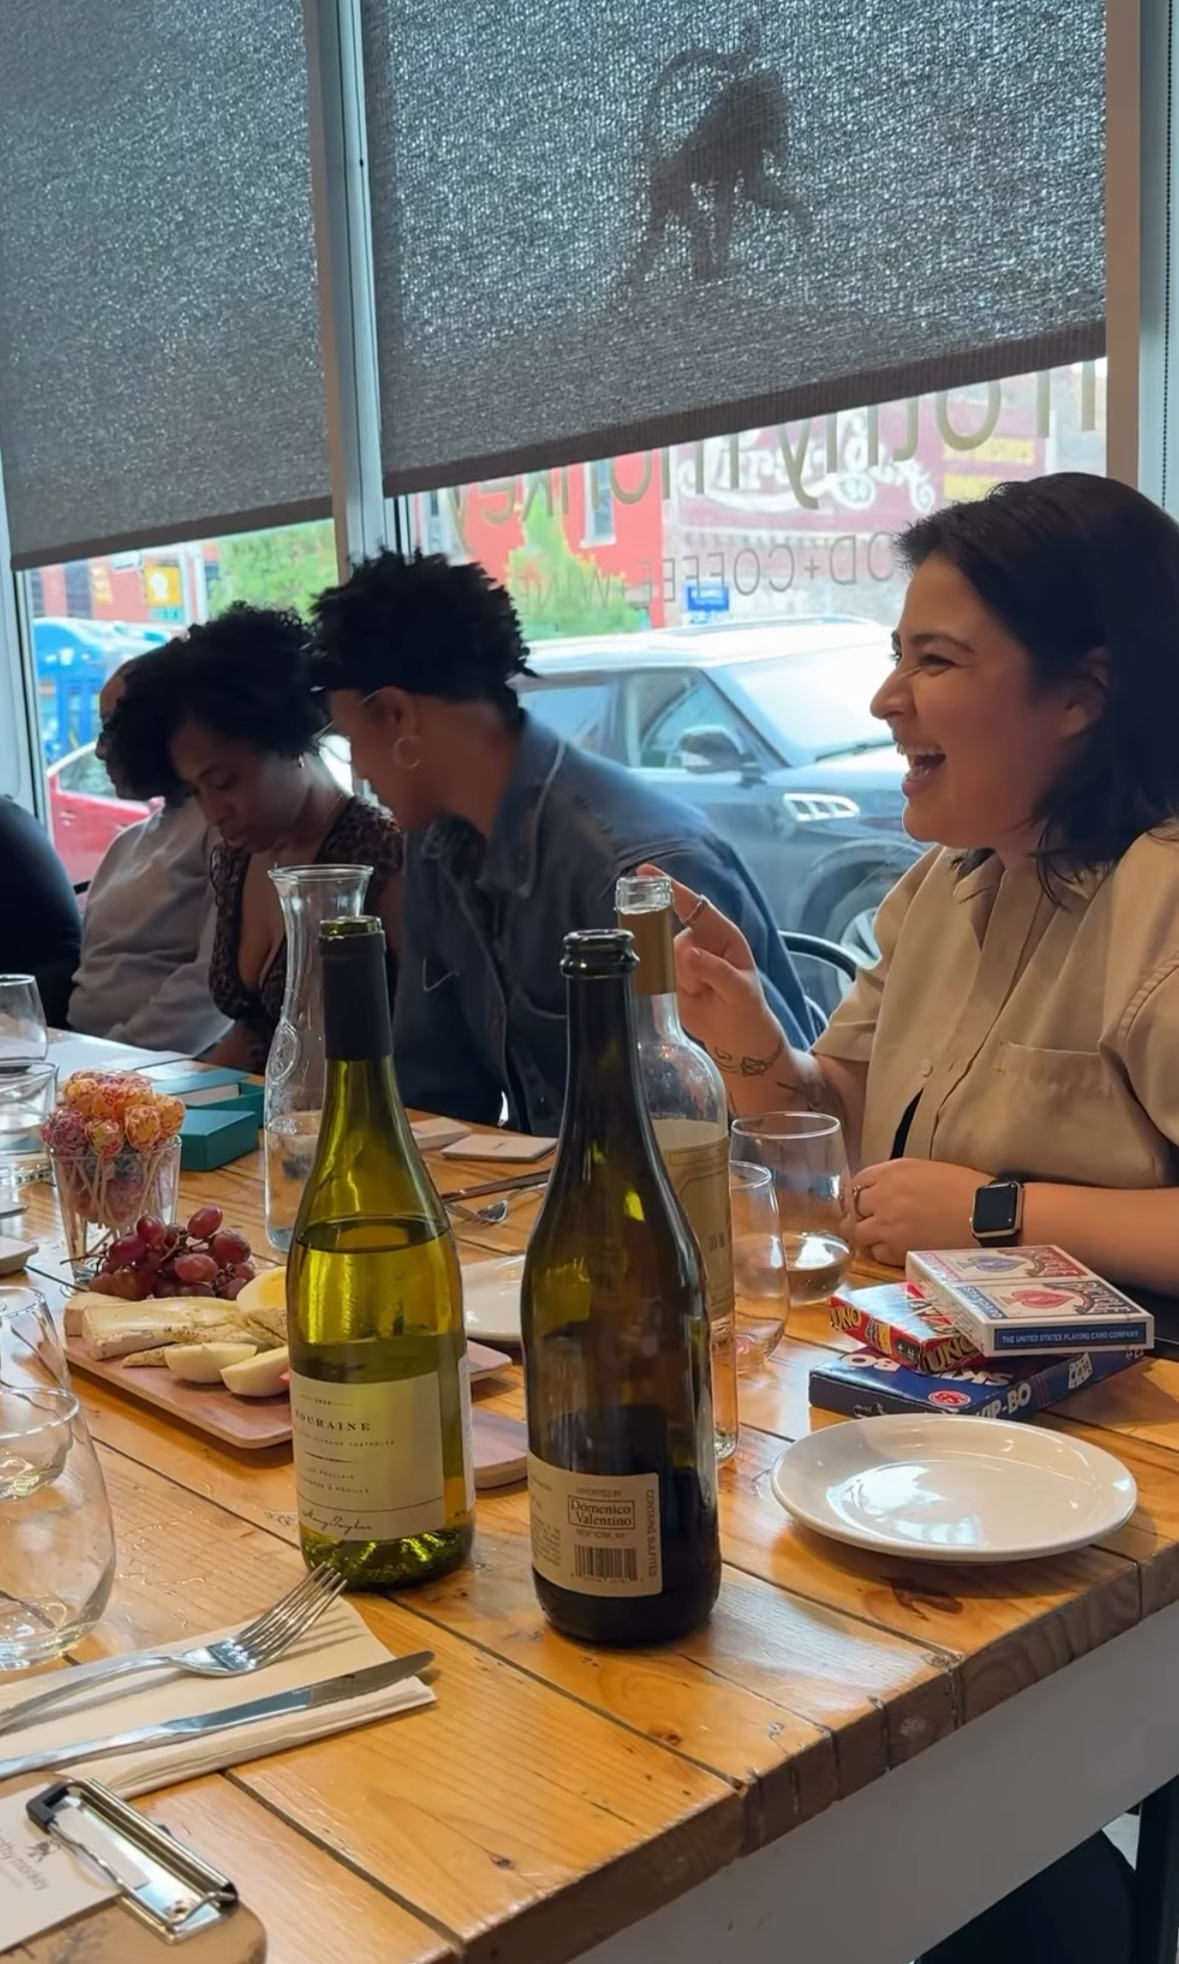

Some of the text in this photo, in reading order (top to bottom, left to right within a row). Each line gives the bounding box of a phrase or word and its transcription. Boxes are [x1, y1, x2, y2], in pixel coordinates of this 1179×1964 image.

[830, 1305, 861, 1331] UNO
[1003, 1330, 1139, 1343] THE UNITED STATES PLAYING CARD COMPANY
[571, 1499, 631, 1514] Domenico
[576, 1511, 632, 1526] Valentino
